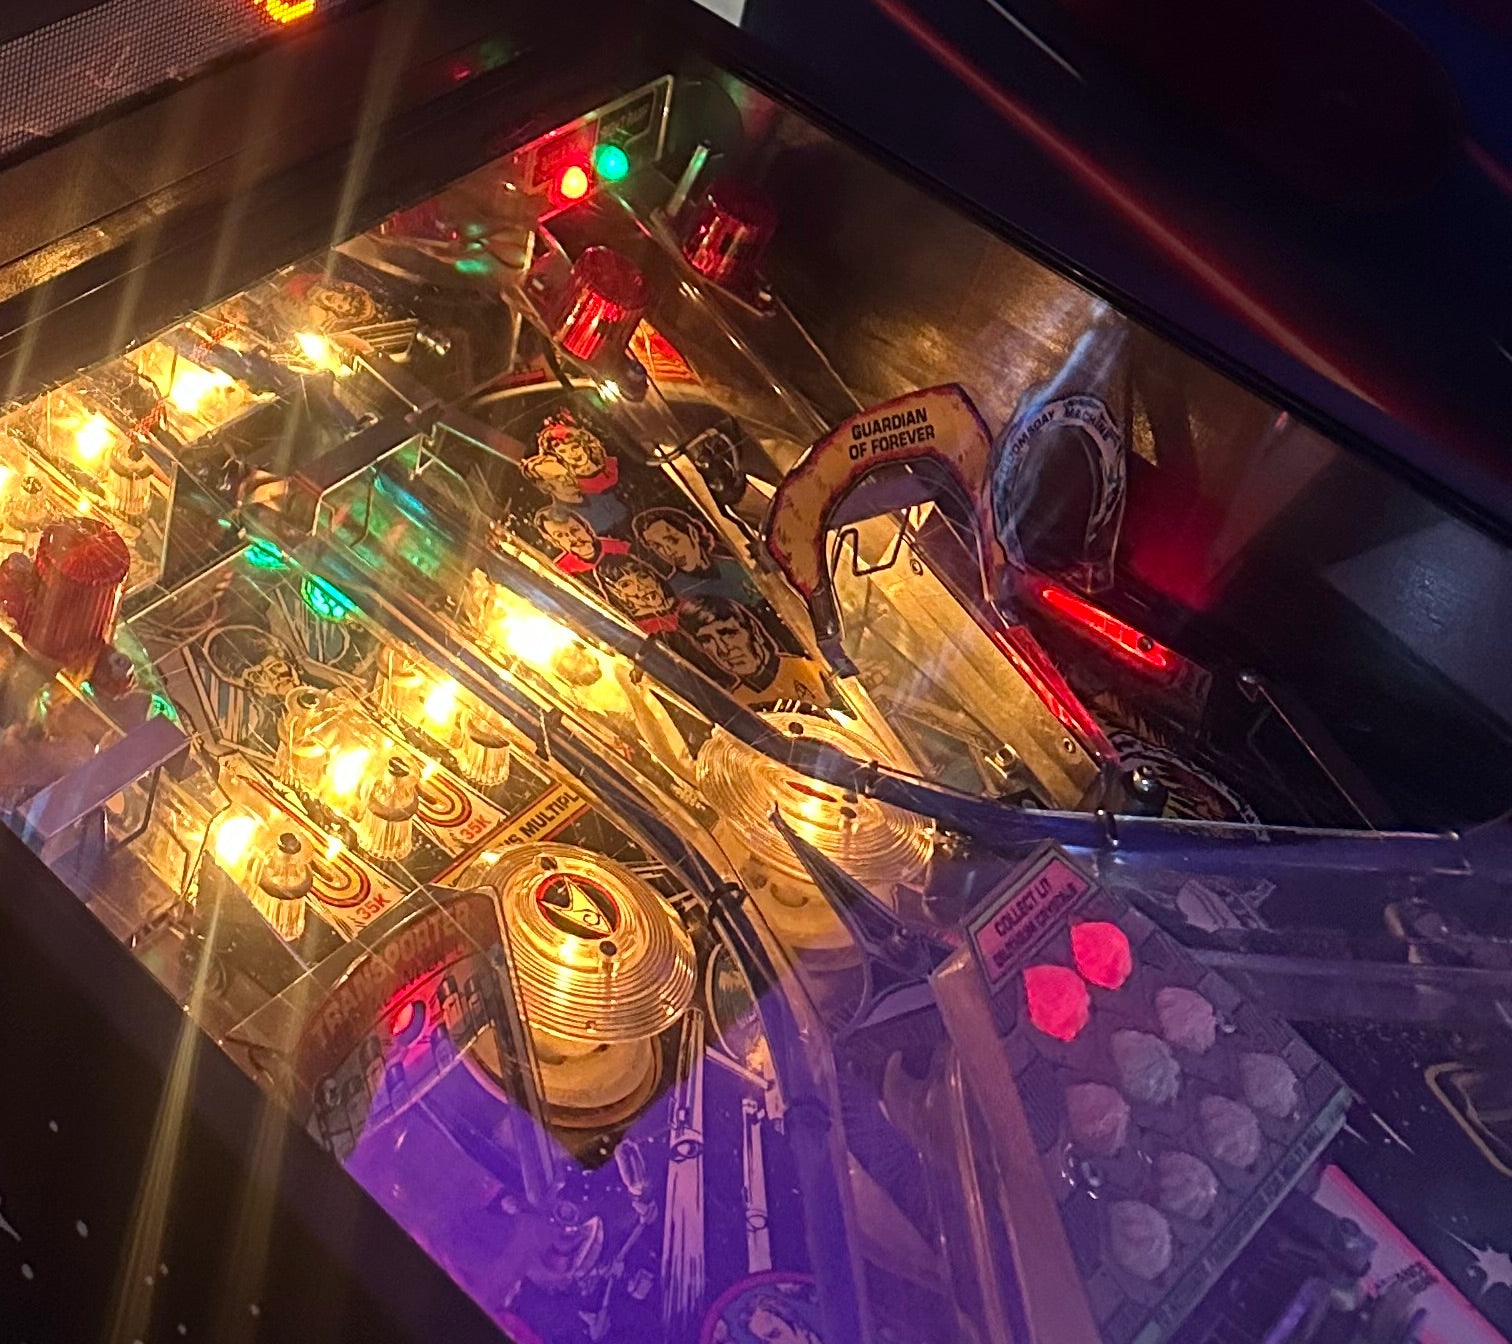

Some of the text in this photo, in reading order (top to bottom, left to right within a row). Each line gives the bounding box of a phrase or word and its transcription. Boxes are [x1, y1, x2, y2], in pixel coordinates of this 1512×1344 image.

[851, 407, 928, 441] GUARDIAN
[1064, 407, 1110, 442] MACHINE
[849, 424, 936, 461] OF FOREVER
[459, 814, 493, 840] 35K
[355, 893, 392, 920] 35K
[994, 891, 1037, 937] COLLECT
[314, 901, 472, 1038] TRANSPORTER
